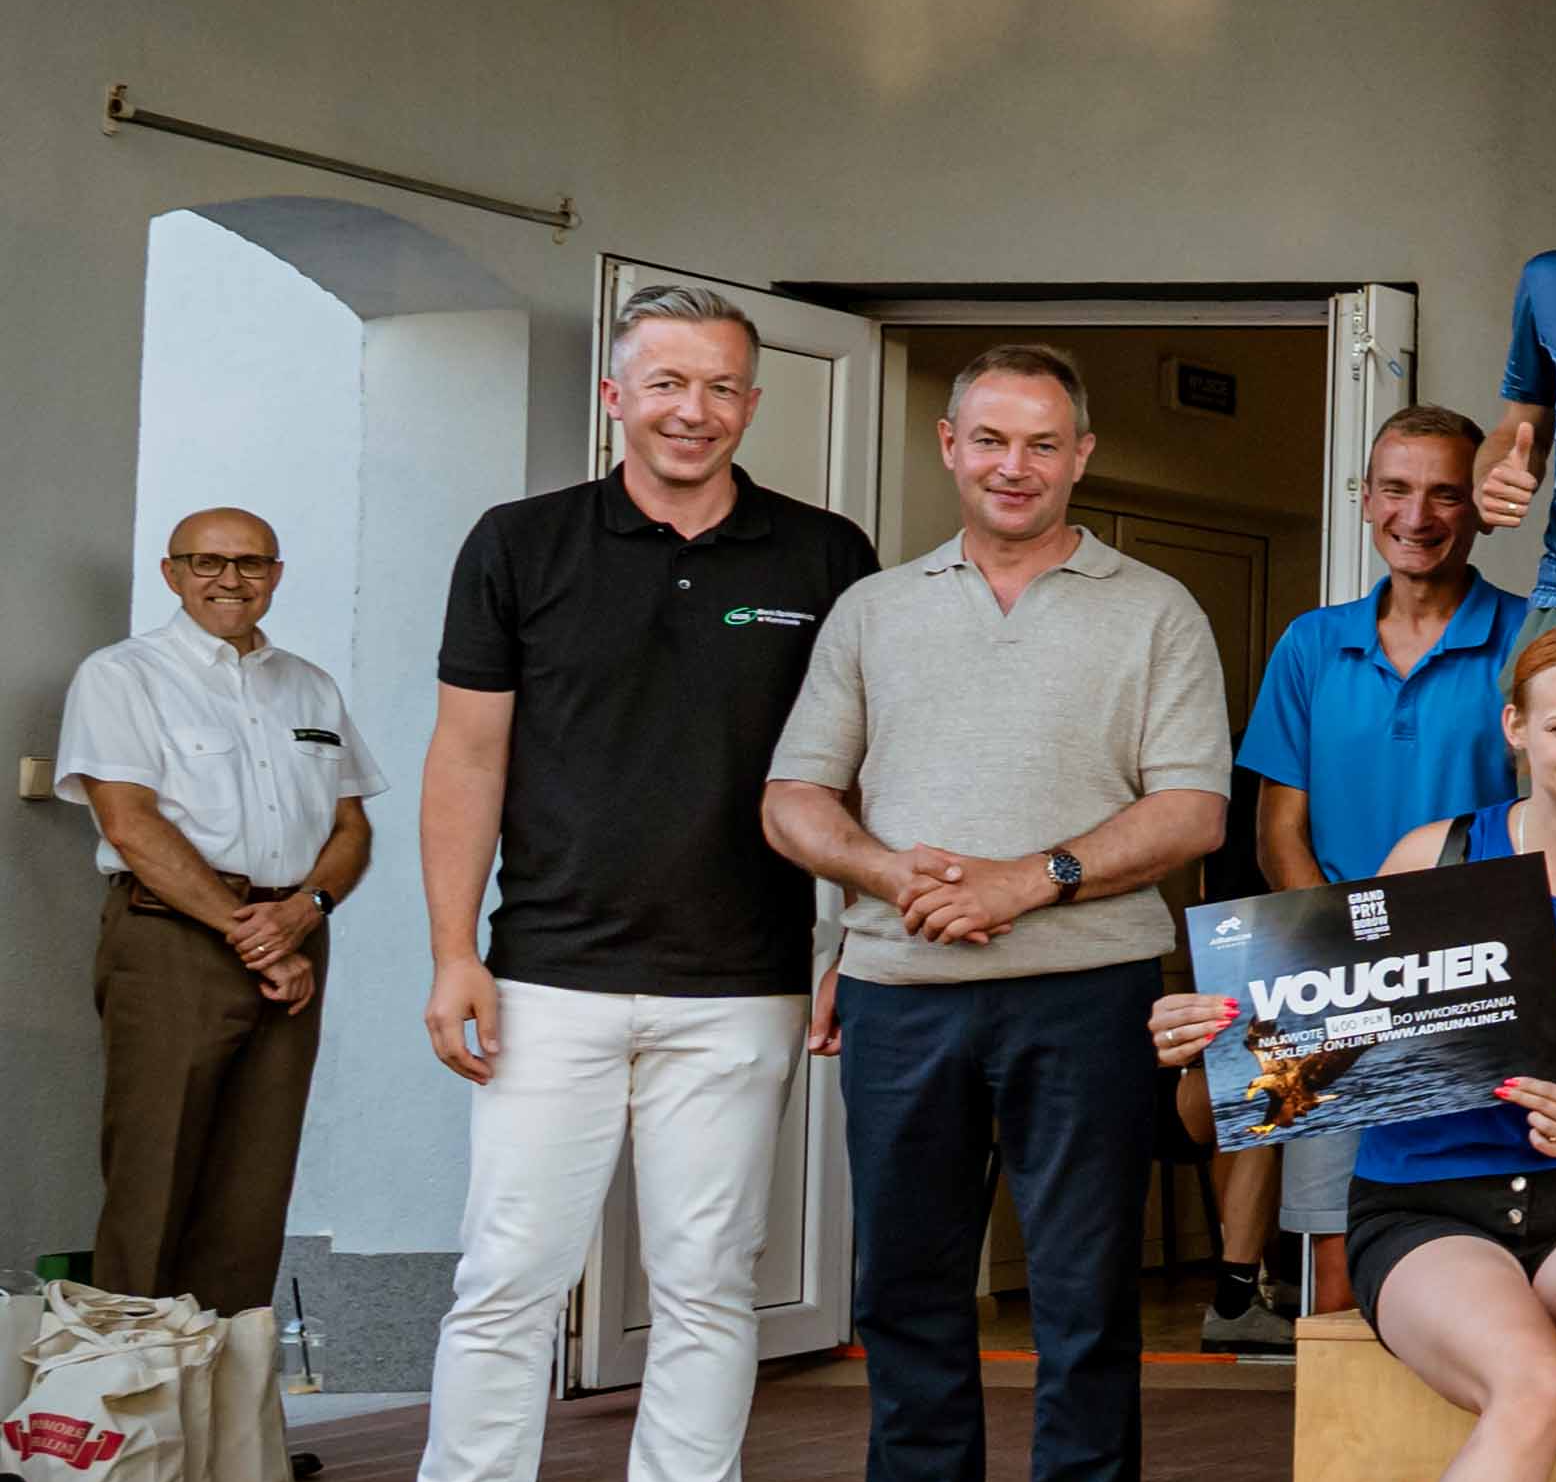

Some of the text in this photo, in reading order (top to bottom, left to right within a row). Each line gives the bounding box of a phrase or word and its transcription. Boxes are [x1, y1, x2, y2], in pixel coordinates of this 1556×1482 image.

[1248, 940, 1512, 1023] VOUCHER
[1392, 1011, 1413, 1026] DO
[1413, 995, 1517, 1024] WYKORZYSTANIA
